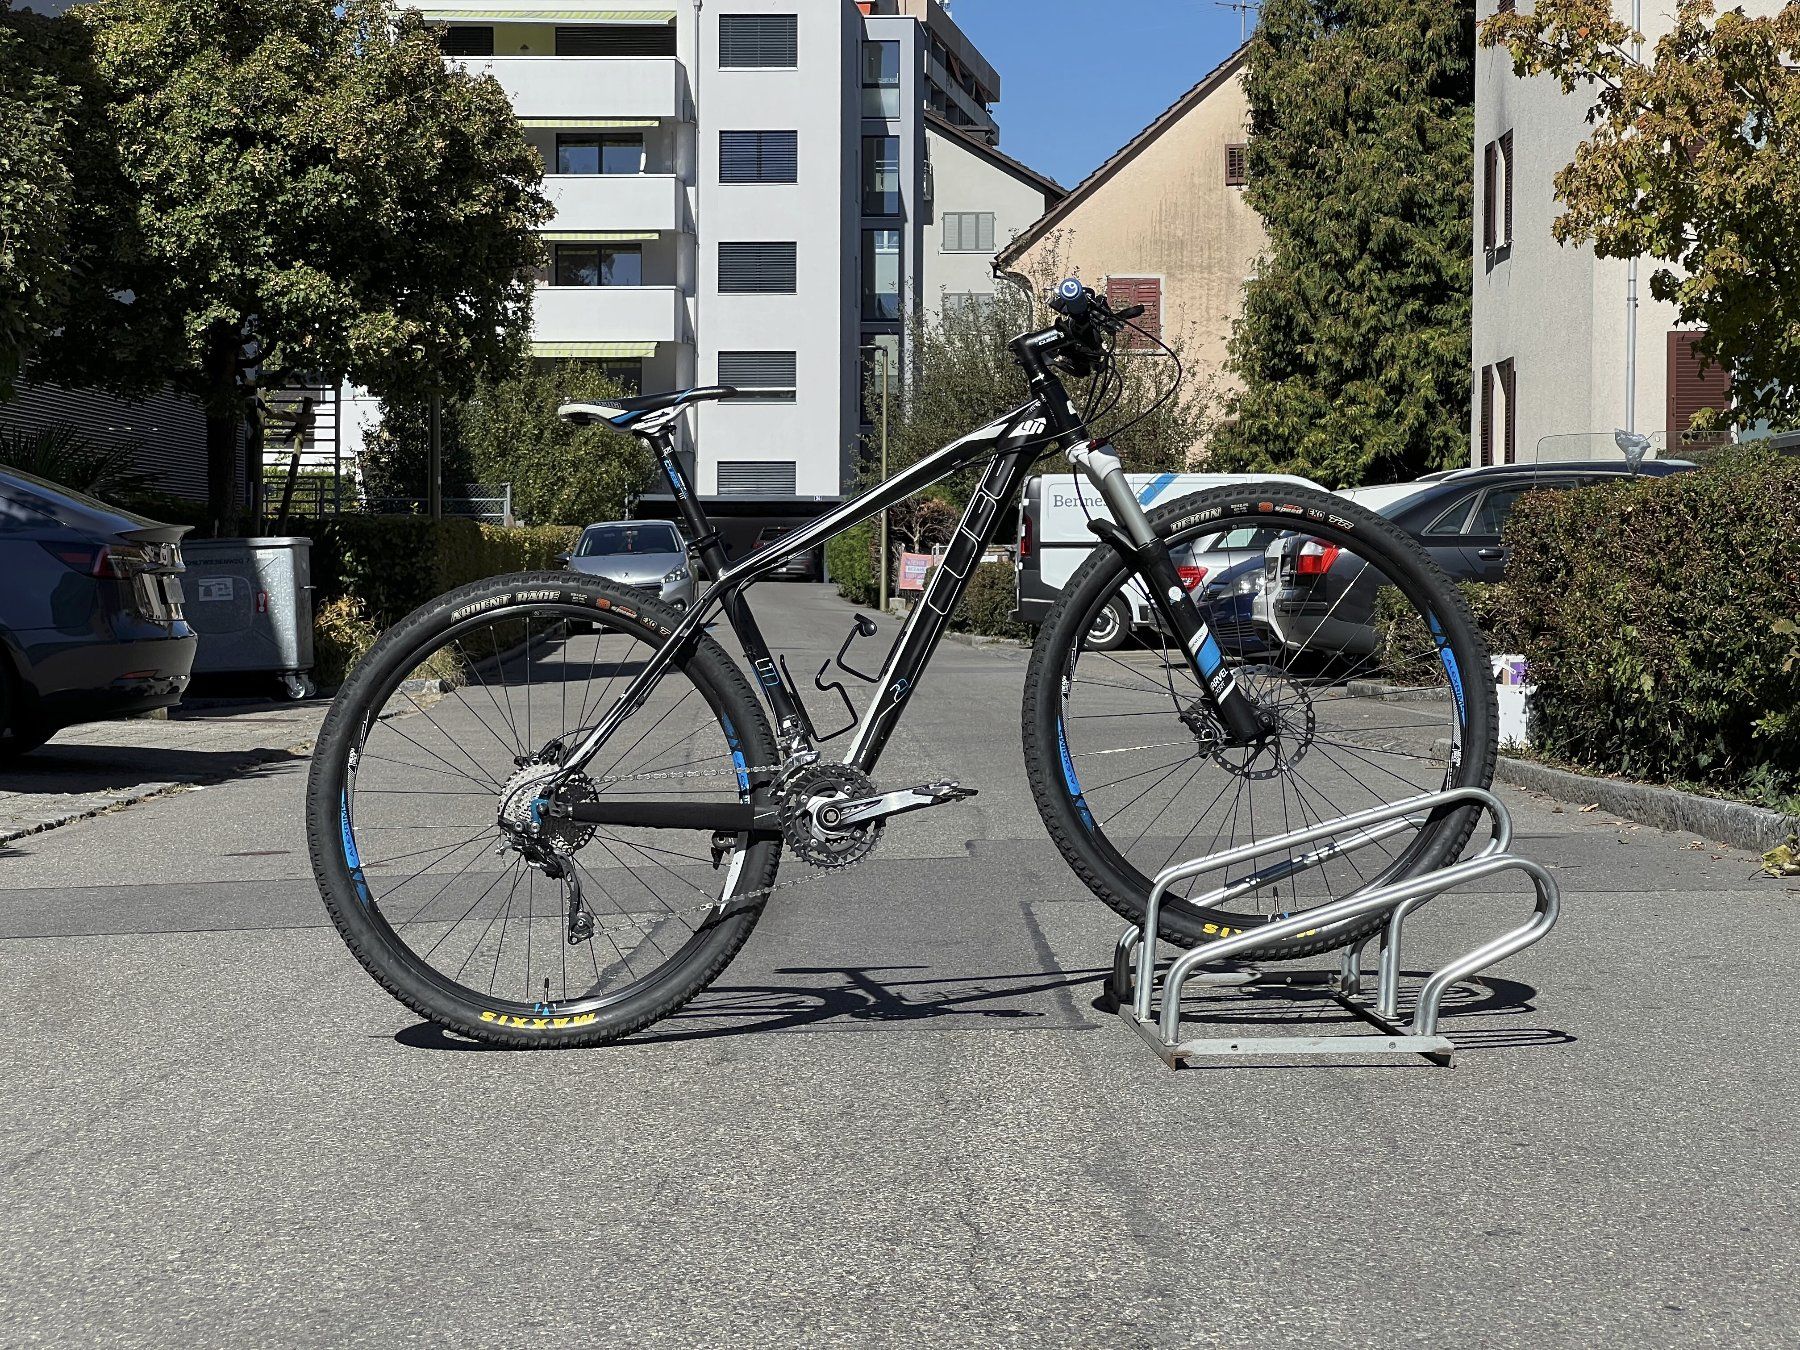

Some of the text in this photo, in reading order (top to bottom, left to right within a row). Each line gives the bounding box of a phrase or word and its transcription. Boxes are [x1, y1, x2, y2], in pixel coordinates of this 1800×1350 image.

[1053, 494, 1107, 508] Benne
[1170, 506, 1221, 533] REKON
[1308, 508, 1326, 521] EXO
[928, 454, 1015, 614] CUBE
[451, 594, 511, 622] ARDENT
[516, 590, 560, 602] RACE
[1210, 667, 1228, 691] ARVEL
[479, 1011, 597, 1030] MAXXIS
